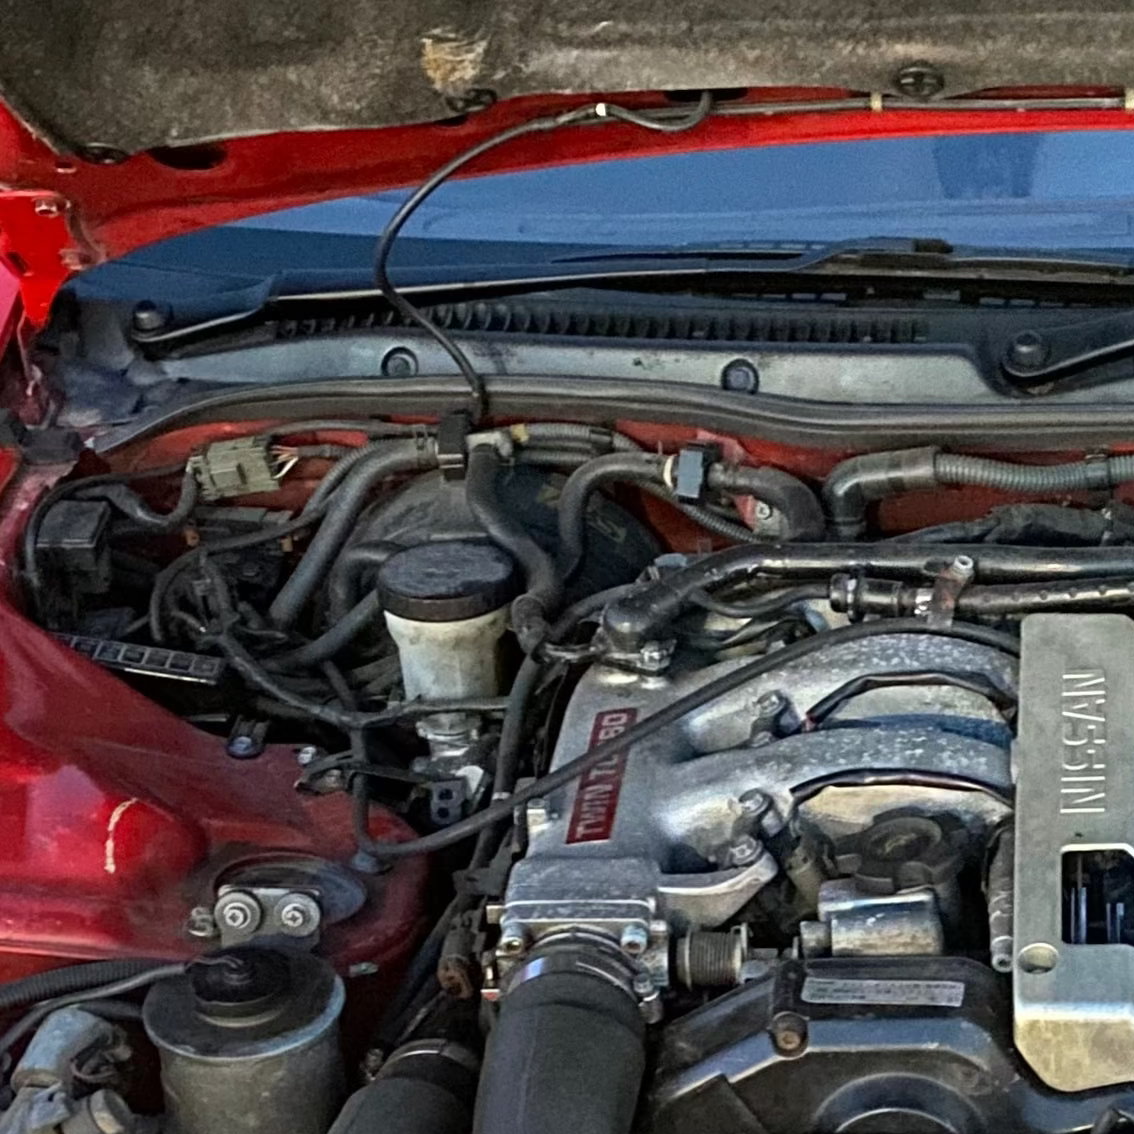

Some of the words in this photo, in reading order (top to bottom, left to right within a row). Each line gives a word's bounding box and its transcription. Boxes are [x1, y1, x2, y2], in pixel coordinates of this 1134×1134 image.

[588, 713, 628, 781] TBO
[1059, 668, 1106, 814] NISSAN
[575, 783, 614, 839] TWIN
